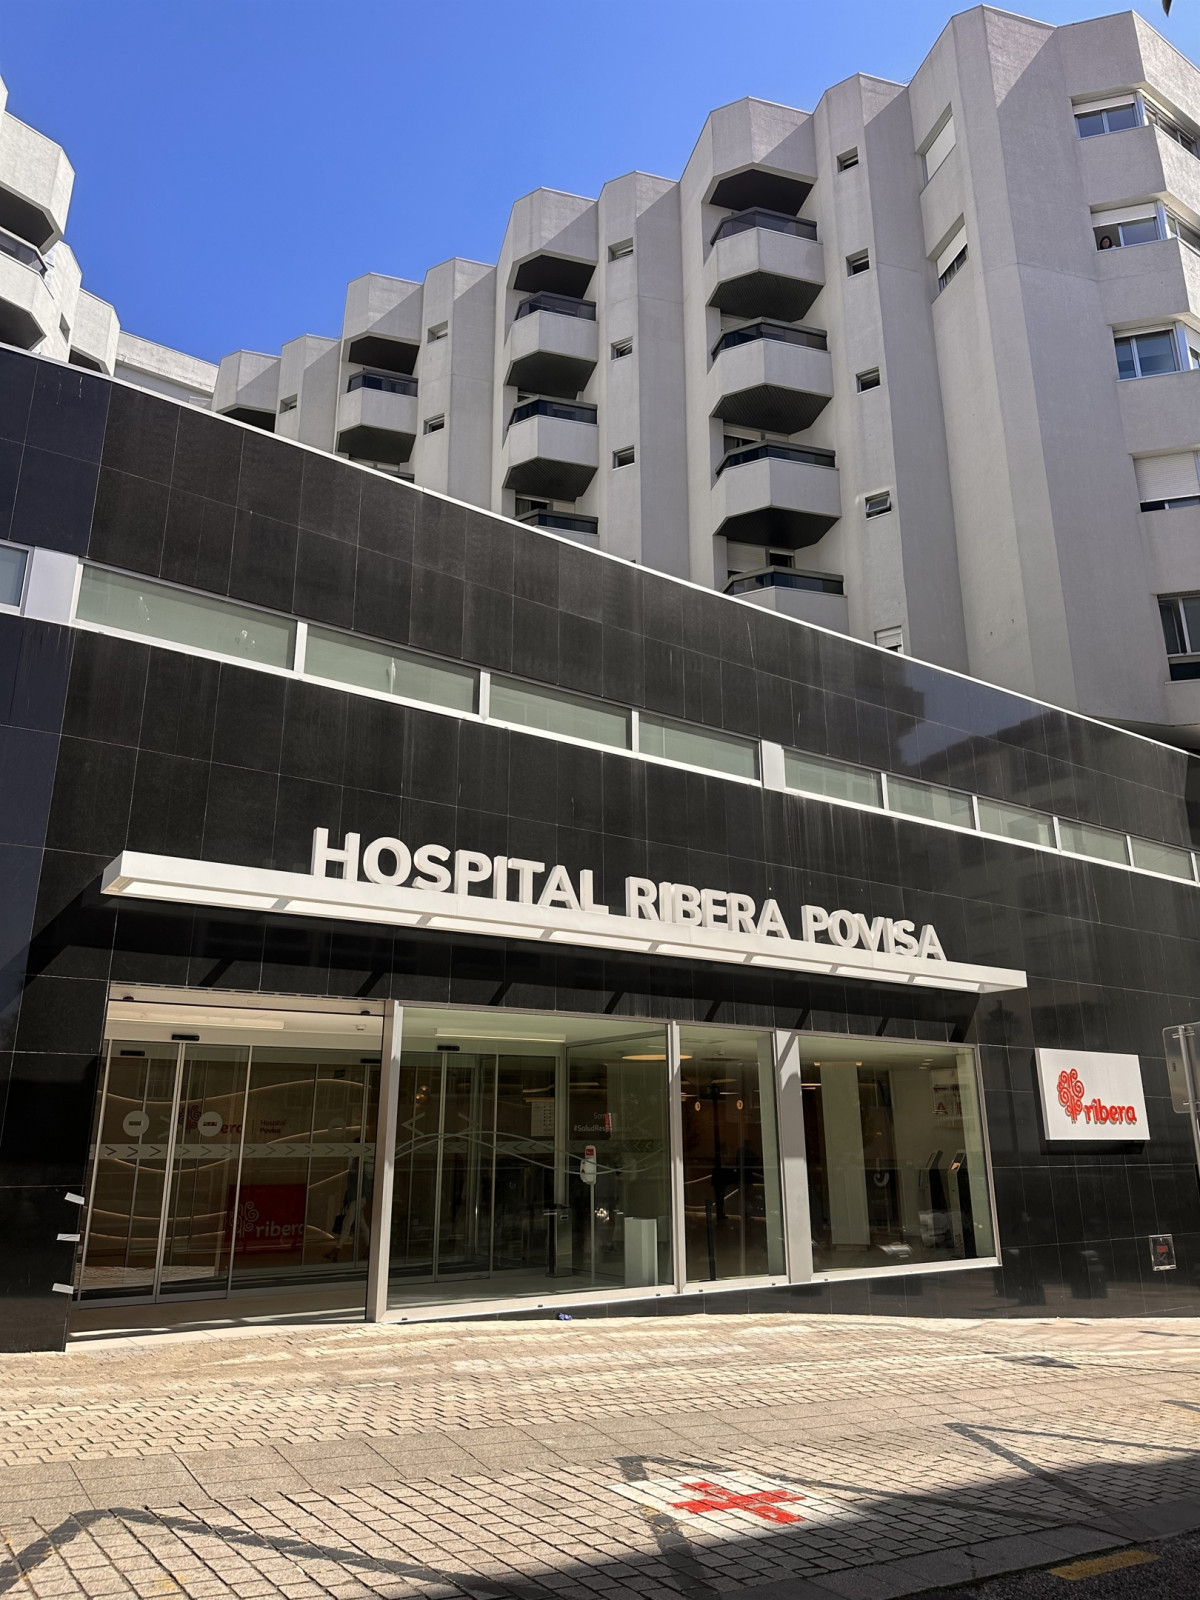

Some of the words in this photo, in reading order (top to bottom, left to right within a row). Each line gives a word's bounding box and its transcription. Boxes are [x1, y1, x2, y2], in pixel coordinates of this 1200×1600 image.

[310, 826, 609, 915] HOSPITAL
[625, 876, 792, 940] RIBERA
[801, 904, 948, 962] POVISA
[1083, 1098, 1138, 1124] ribera
